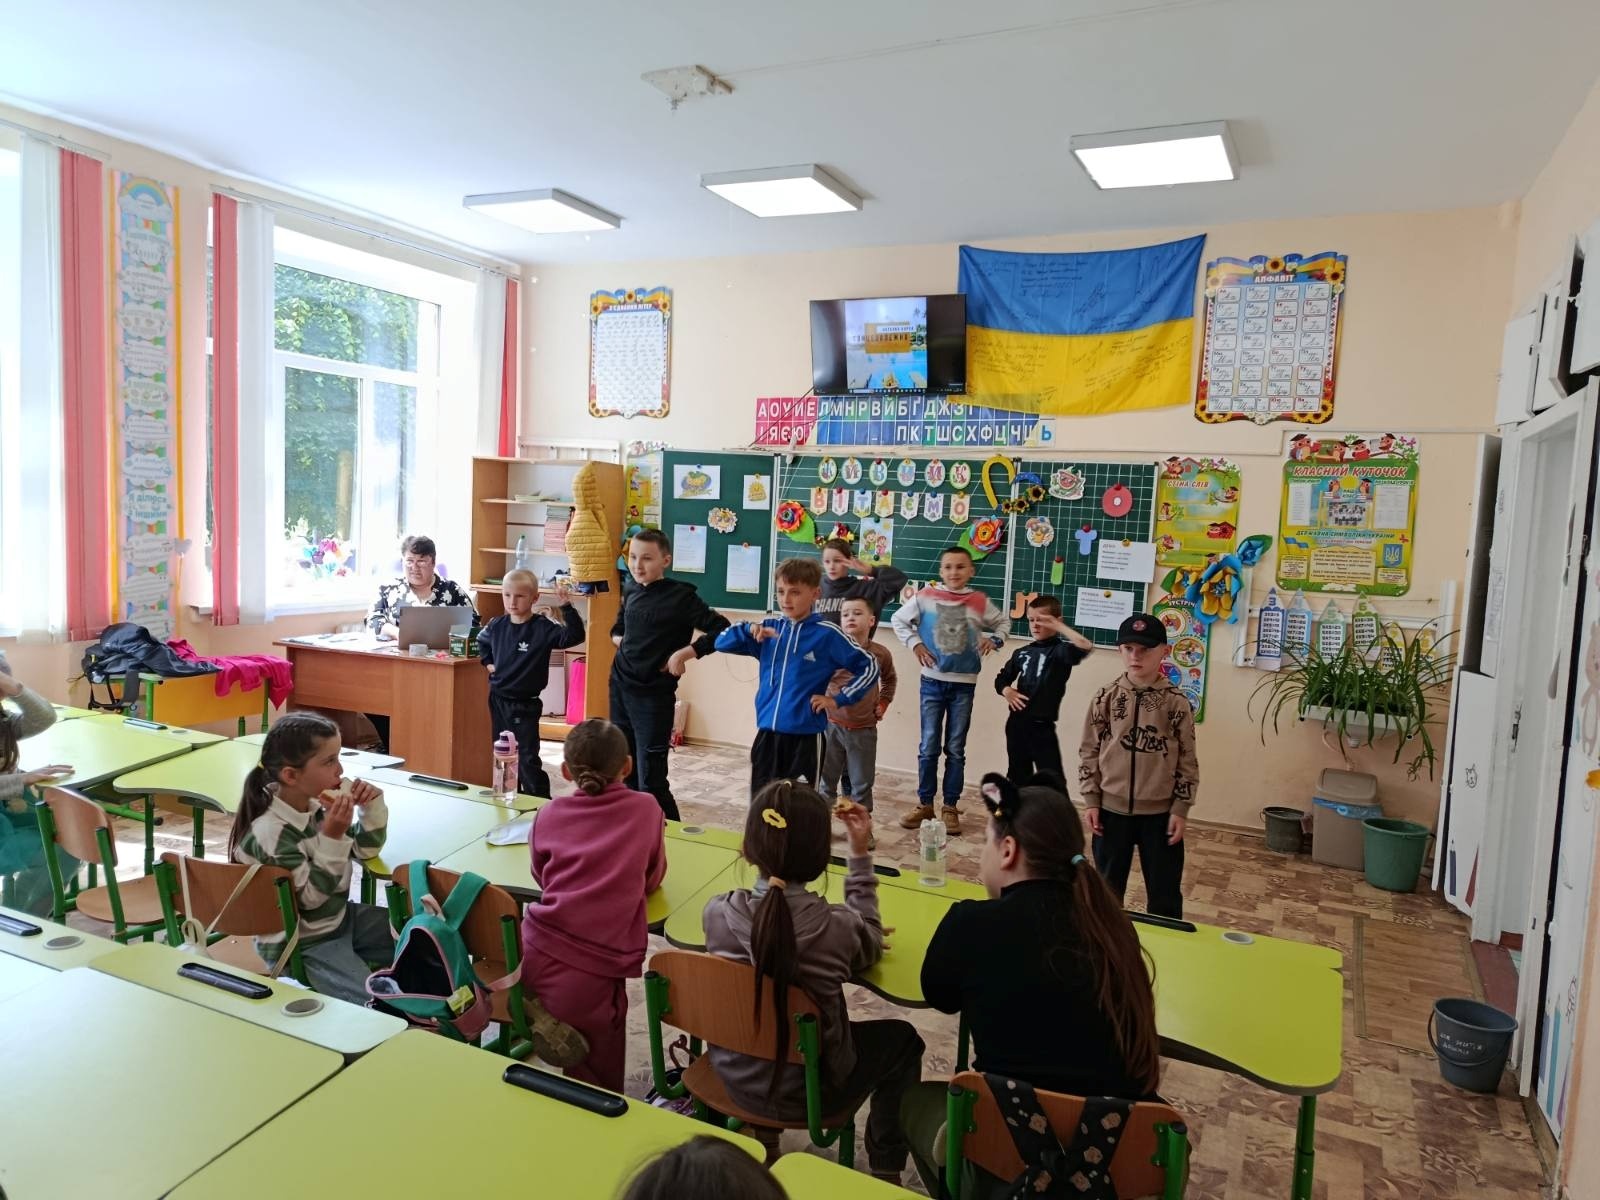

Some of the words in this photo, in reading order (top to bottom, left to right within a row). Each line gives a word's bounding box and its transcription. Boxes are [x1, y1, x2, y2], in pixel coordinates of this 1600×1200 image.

[1254, 274, 1294, 283] АЛФАВІТ
[1294, 465, 1349, 476] КЛАСНИЙ
[1352, 466, 1407, 478] КУТОЧОК
[814, 494, 965, 516] ВІТАЄМО
